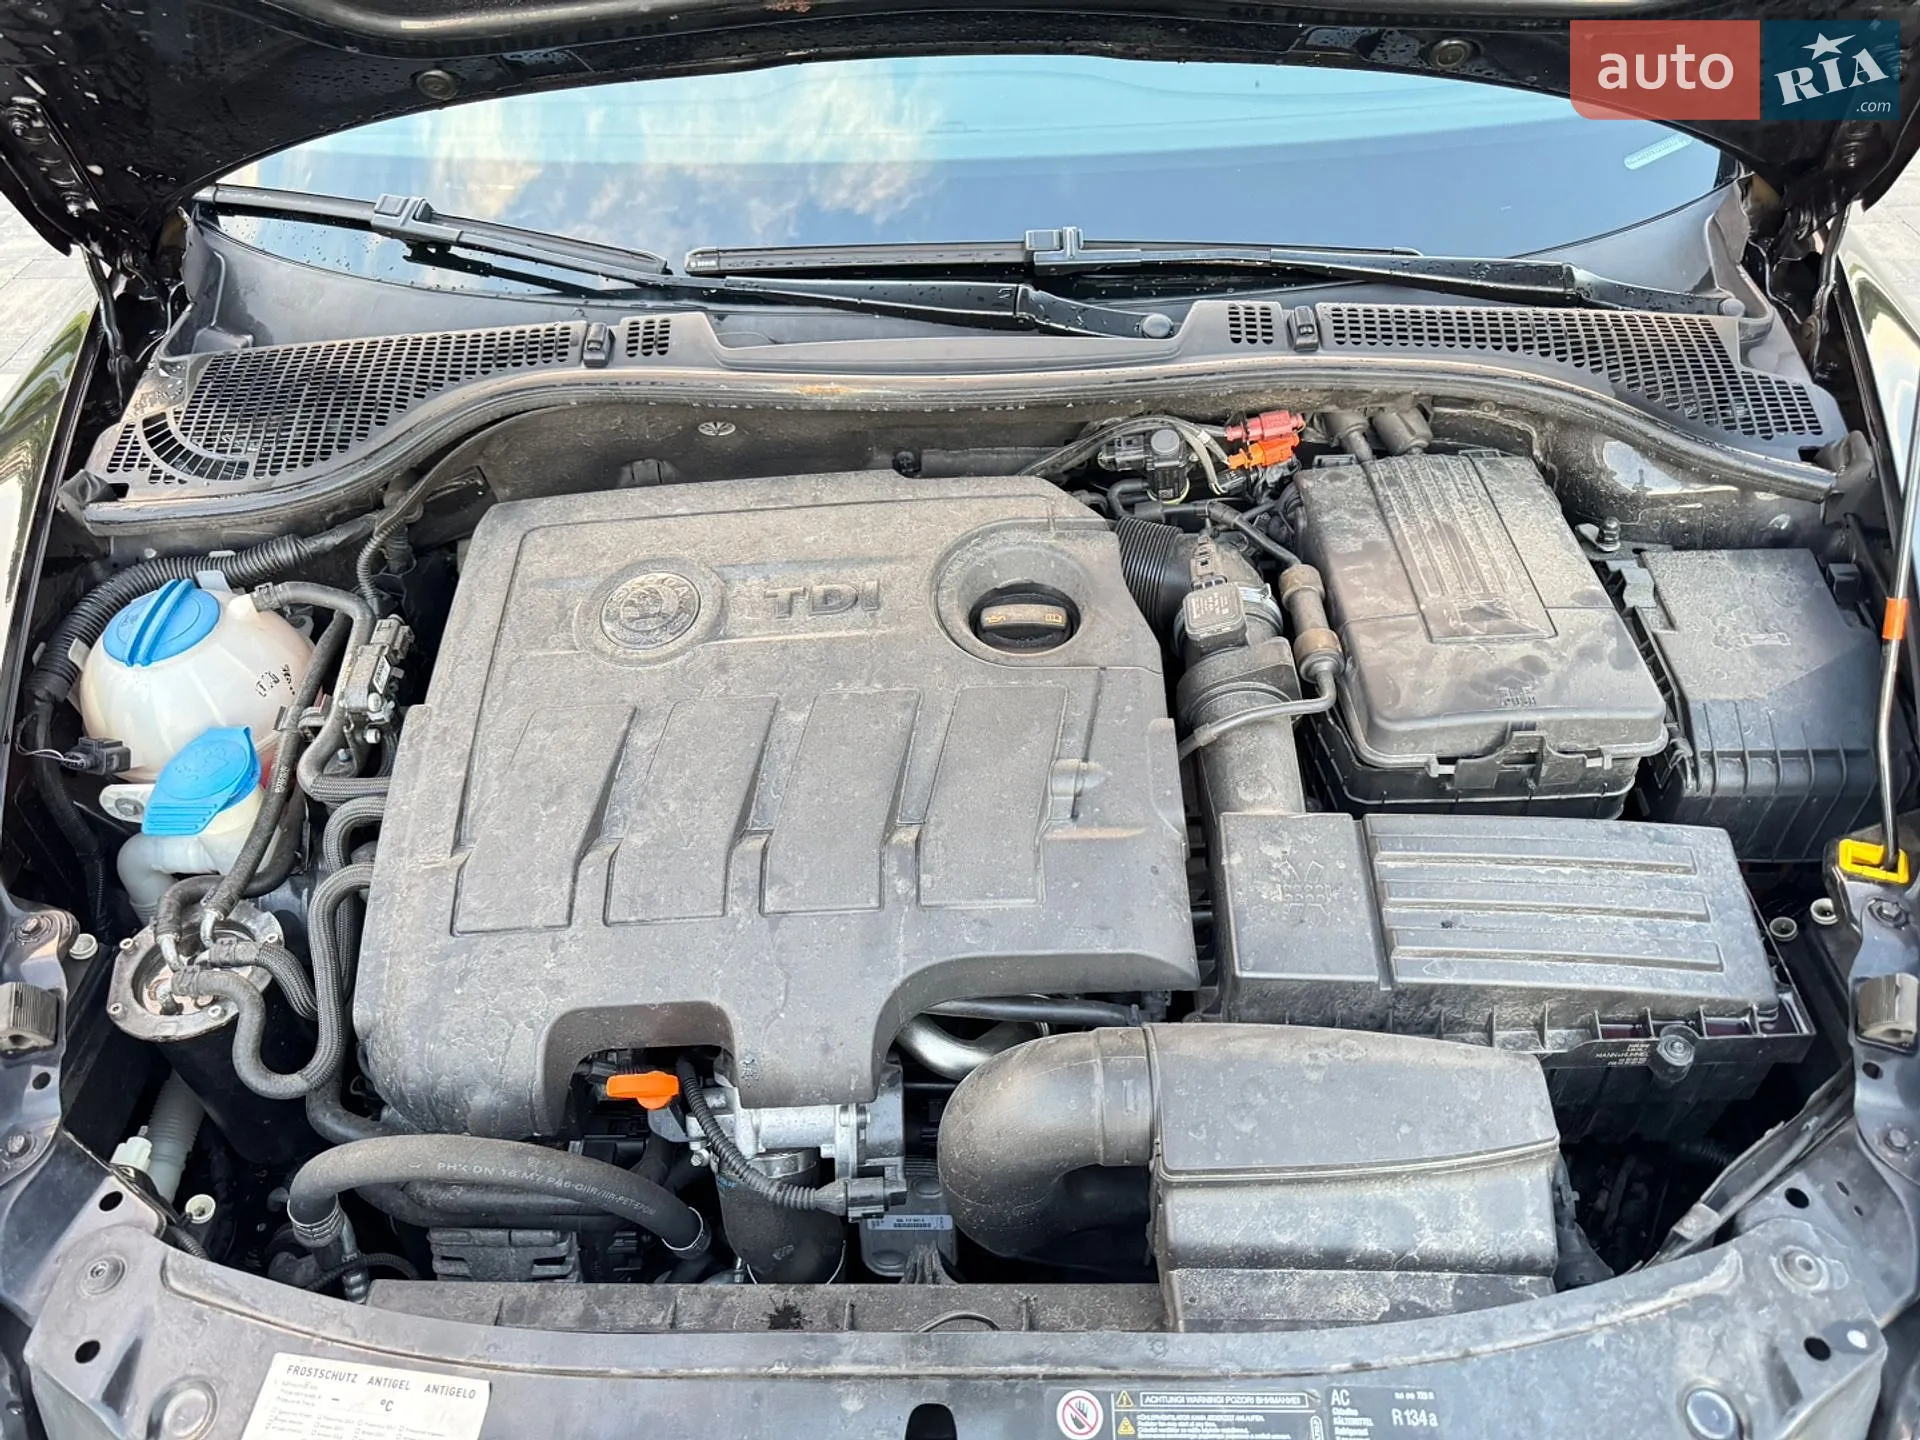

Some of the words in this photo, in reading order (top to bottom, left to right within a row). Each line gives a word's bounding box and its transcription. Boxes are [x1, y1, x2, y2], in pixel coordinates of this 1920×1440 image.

[764, 580, 879, 619] TDI
[287, 1365, 358, 1384] FROSTSCHUTZ
[367, 1376, 411, 1391] ANTIGEL
[424, 1384, 476, 1400] ANTIGELO
[1331, 1388, 1351, 1406] AC
